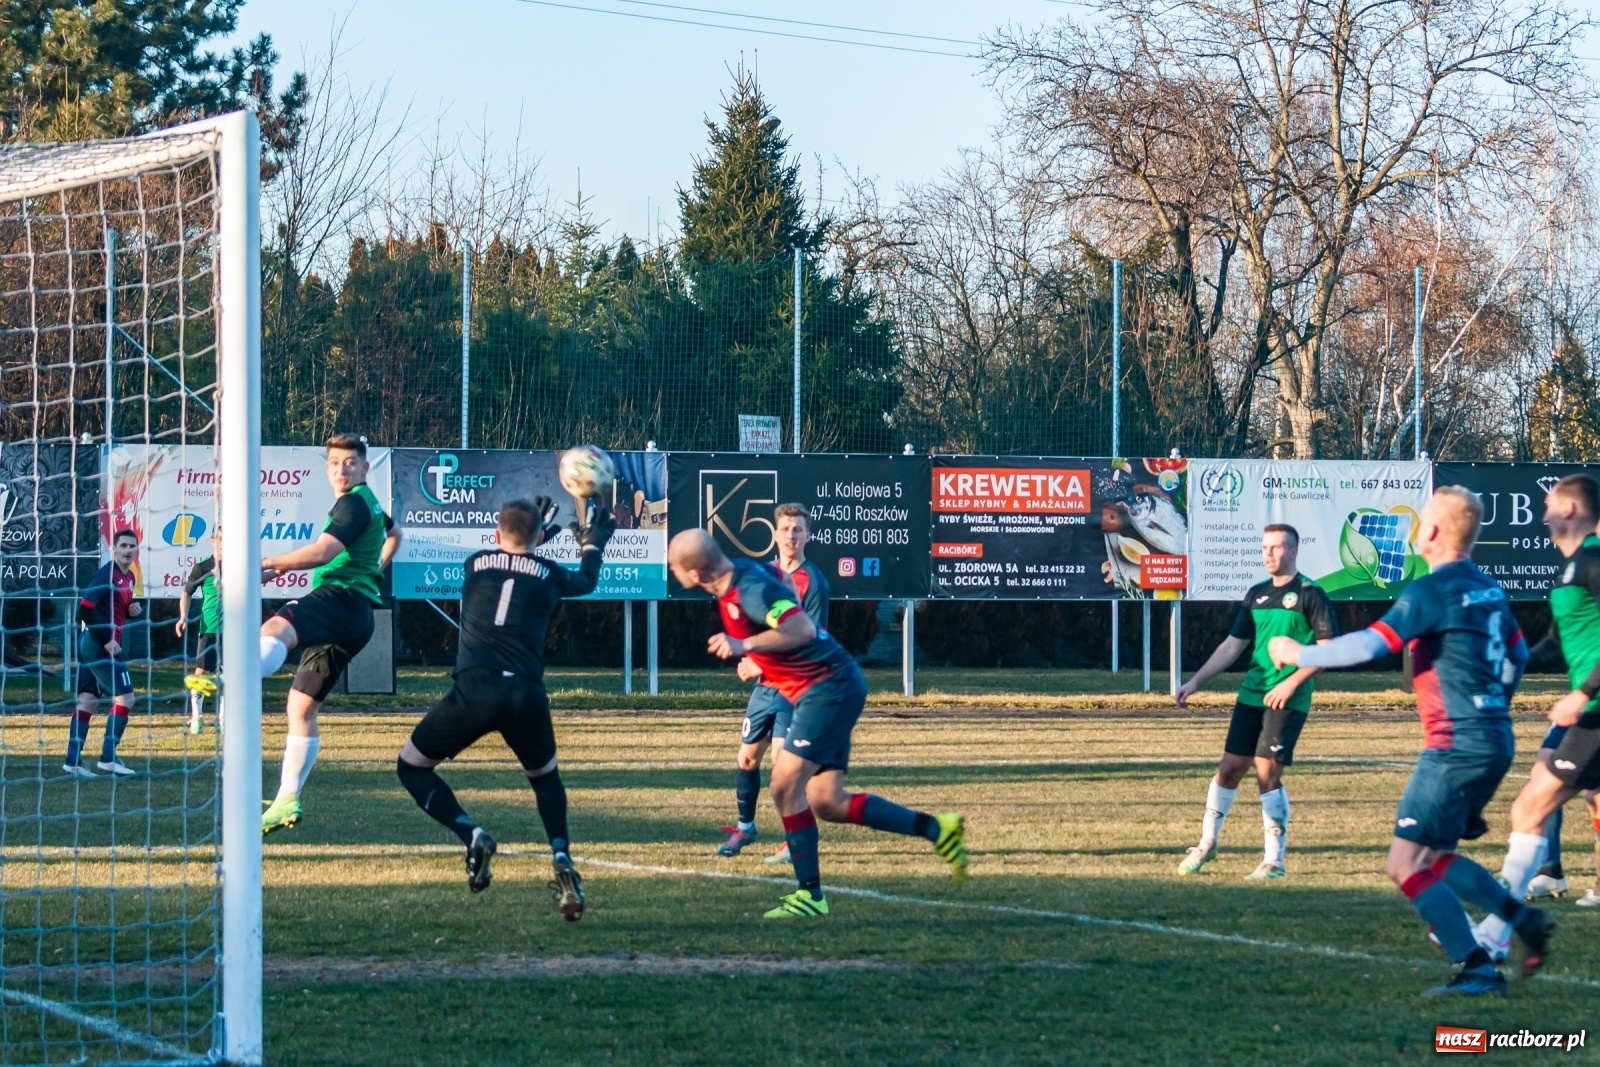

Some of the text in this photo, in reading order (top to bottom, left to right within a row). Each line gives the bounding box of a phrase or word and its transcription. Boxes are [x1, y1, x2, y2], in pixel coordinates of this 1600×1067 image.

[177, 468, 222, 485] Firm
[939, 473, 1085, 498] KREWETKA
[1263, 477, 1422, 490] GM-INSTAL tel. 667 843 022
[184, 488, 214, 497] Helena
[271, 489, 303, 498] Michna
[816, 482, 902, 501] ul. Kolejowa 5
[1262, 491, 1330, 500] Marek Gawliczek
[939, 498, 1084, 509] SKLEP RYBNY & SMAŻALNIA
[405, 510, 500, 525] AGENCJA PRAC
[810, 505, 909, 521] 47-450 Roszków
[939, 513, 1086, 526] RYBY ŚWIEŻE, MROŻONE, WĘDZONE
[1204, 523, 1256, 532] instalacje C.O.
[409, 533, 461, 546] Wyzwolenia 2
[809, 529, 909, 544] +48 698 061 803
[1204, 535, 1239, 545] instalacje
[408, 549, 436, 559] 47-450
[537, 547, 572, 559] RANŻY
[938, 544, 977, 555] RACIBÓRZ
[1204, 547, 1263, 557] instalacje gazow
[474, 553, 509, 573] ADAM
[938, 563, 1085, 573] UL. ZBOROWA 5A tel. 32 415 22 32
[1204, 559, 1239, 569] instalacje
[19, 565, 67, 578] POLAK
[615, 567, 639, 580] 551
[1494, 565, 1510, 575] UL.
[1512, 565, 1559, 575] MICKIEW
[938, 577, 952, 586] UL.
[954, 576, 991, 586] OCICKA
[993, 576, 1000, 586] 5
[1006, 577, 1020, 586] tel.
[1021, 578, 1030, 586] 32
[1031, 578, 1046, 586] 666
[1053, 578, 1067, 586] 111
[1149, 576, 1183, 585] WĘDZARNI
[1204, 571, 1253, 582] pompy ciepła
[1204, 584, 1248, 593] rekuperacja
[1525, 580, 1550, 589] PLAC
[494, 578, 515, 626] 1
